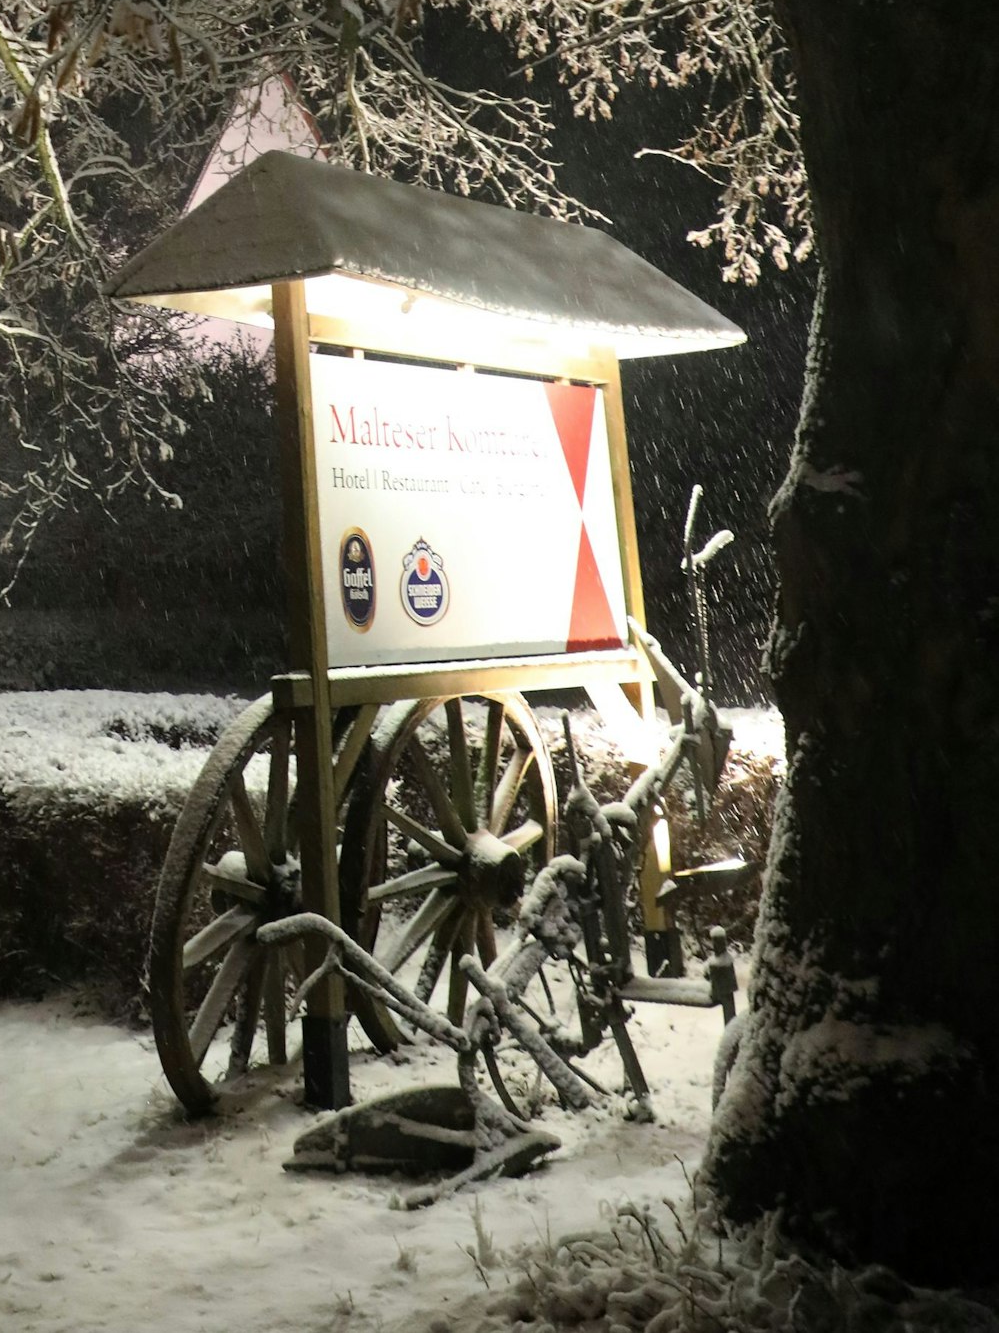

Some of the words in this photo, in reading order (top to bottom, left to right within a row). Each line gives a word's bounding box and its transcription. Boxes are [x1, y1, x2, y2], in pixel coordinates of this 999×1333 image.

[329, 404, 436, 451] Malteser
[332, 467, 370, 490] Hotel
[382, 469, 449, 492] Restaurant
[343, 568, 373, 588] Gaffel
